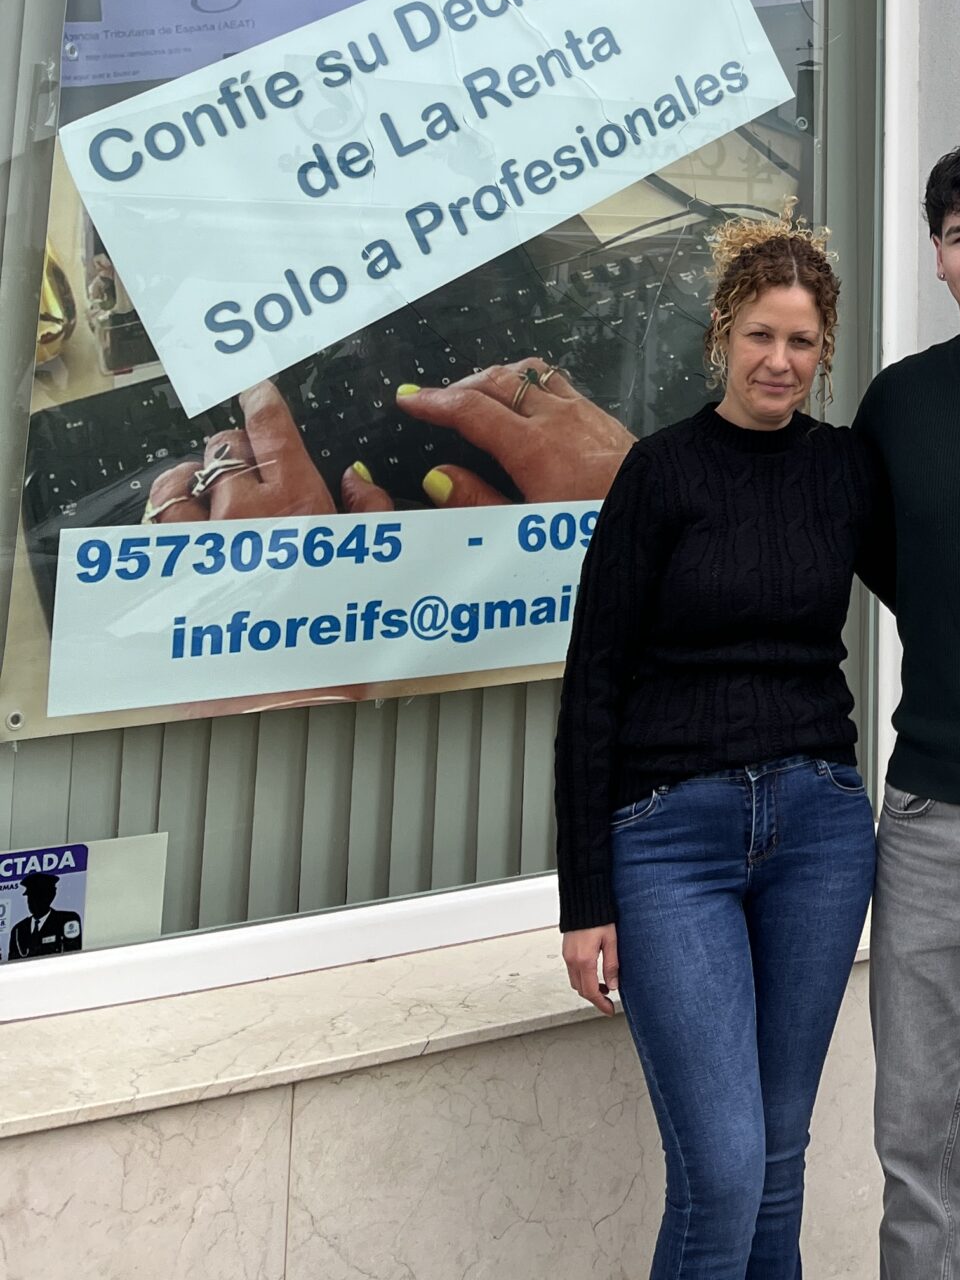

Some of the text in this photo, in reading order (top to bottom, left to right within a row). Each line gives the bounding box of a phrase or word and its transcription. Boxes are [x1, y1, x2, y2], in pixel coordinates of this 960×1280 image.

[88, 70, 304, 182] Confíe
[315, 32, 388, 88] su
[297, 26, 621, 198] de La Renta
[204, 264, 347, 354] Solo
[361, 238, 402, 280] a
[405, 61, 750, 255] Profesionales
[76, 522, 402, 584] 957305645
[0, 851, 76, 877] CTADA
